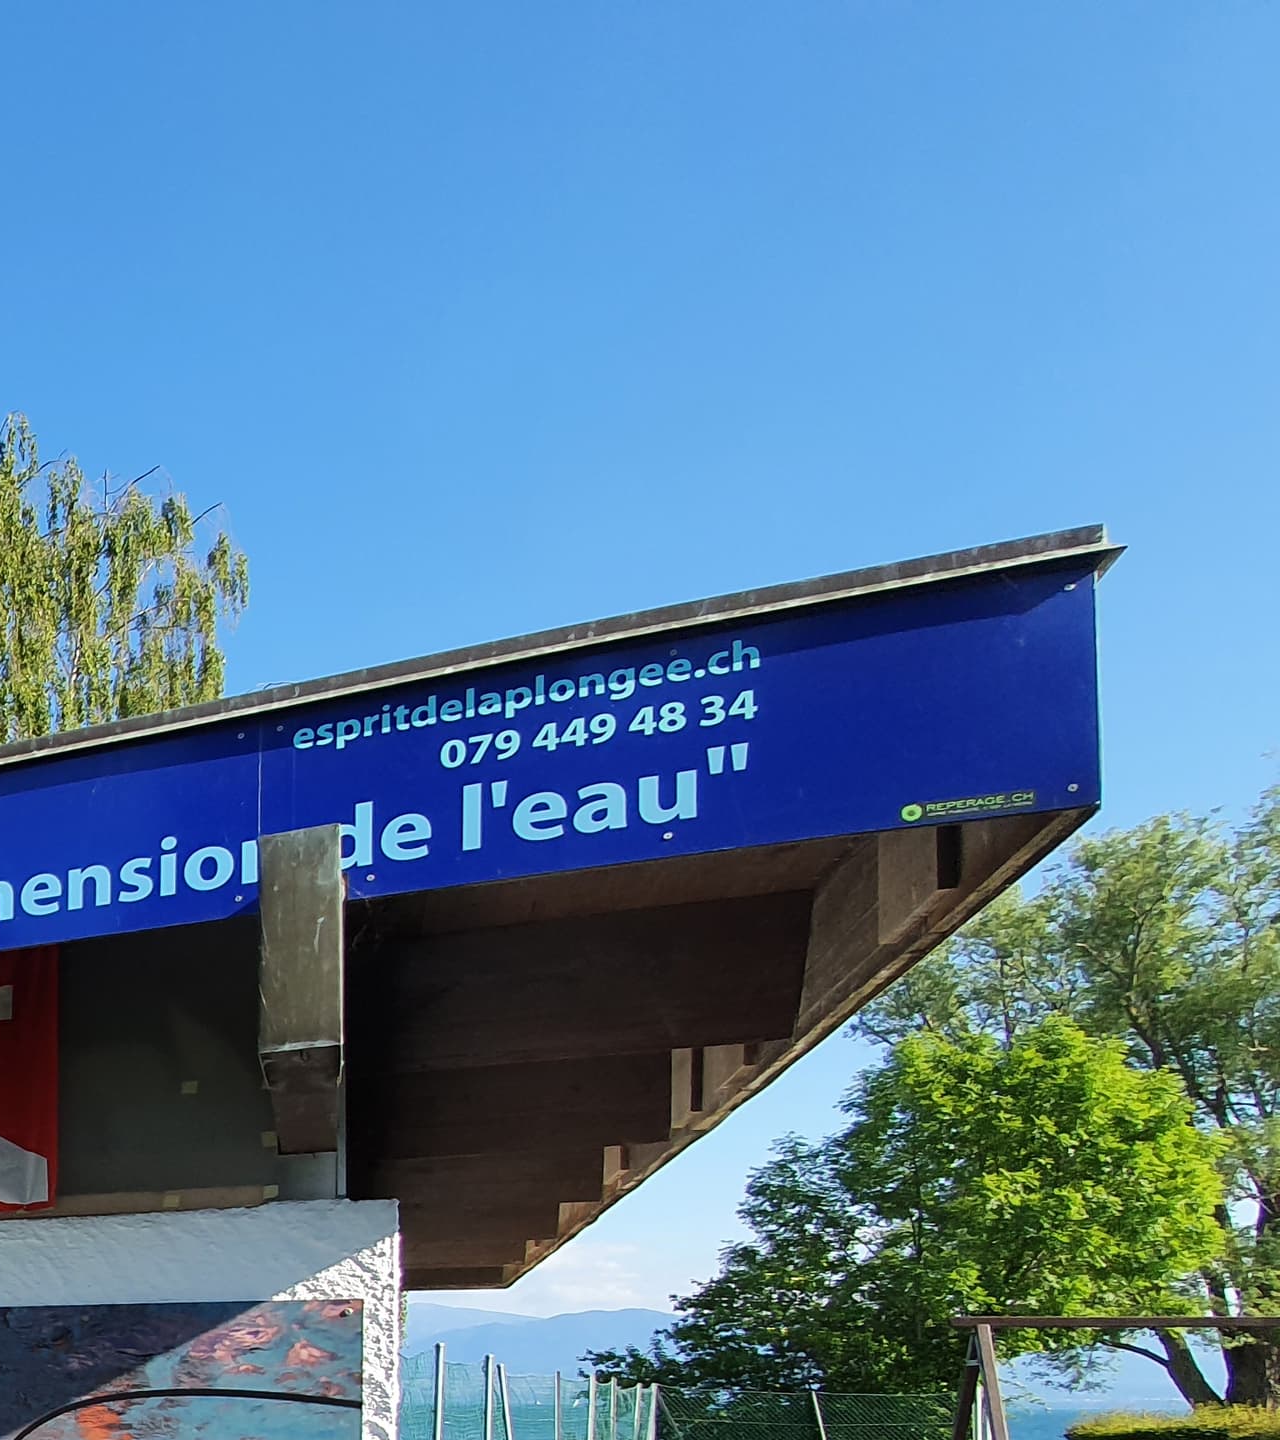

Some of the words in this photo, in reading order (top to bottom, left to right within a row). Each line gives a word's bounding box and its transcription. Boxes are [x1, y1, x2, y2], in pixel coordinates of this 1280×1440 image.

[293, 640, 761, 750] espritdelaplongee.ch
[441, 730, 521, 769] 079
[531, 714, 617, 752] 449
[628, 702, 687, 736] 48
[699, 690, 759, 727] 34
[339, 800, 432, 872] de
[462, 742, 750, 852] l'eau"
